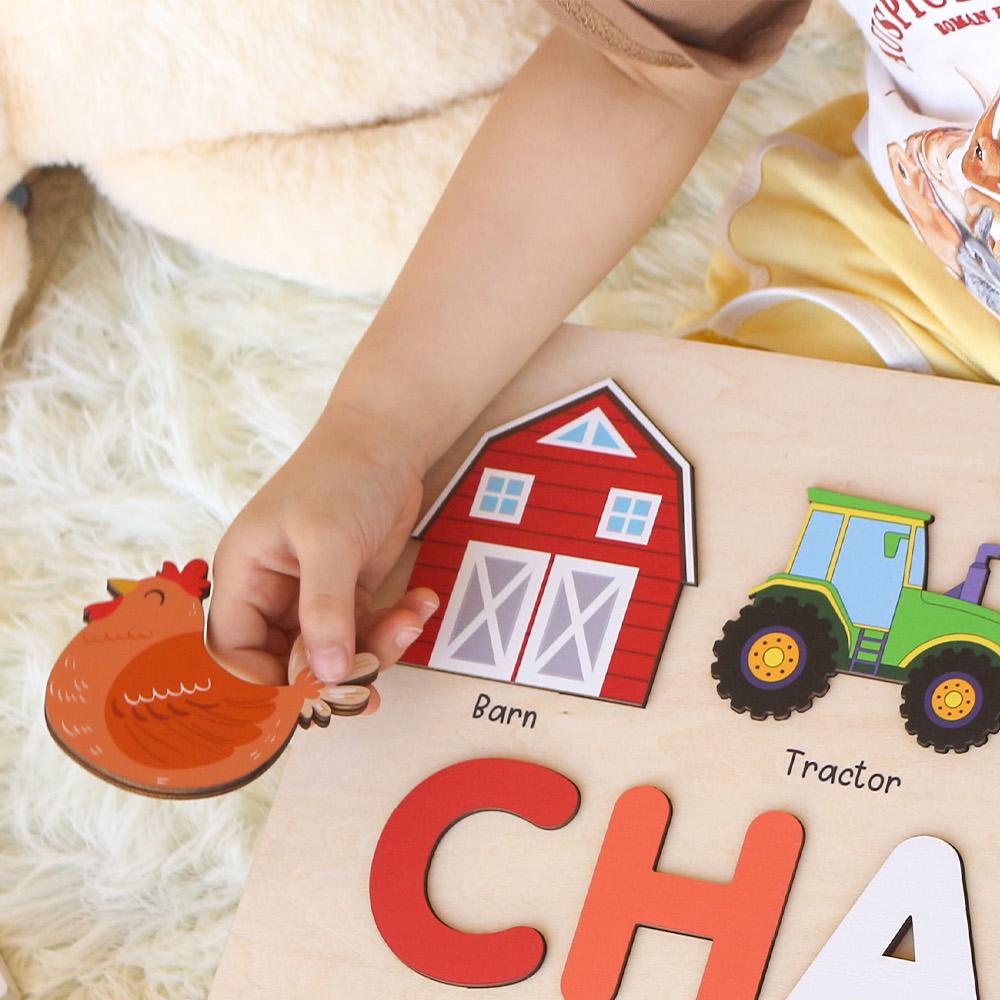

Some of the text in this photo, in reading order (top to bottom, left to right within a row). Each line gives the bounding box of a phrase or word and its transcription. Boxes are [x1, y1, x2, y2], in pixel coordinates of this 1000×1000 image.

[934, 9, 991, 36] ROMAN
[472, 694, 538, 730] Barn
[785, 748, 902, 795] Tractor
